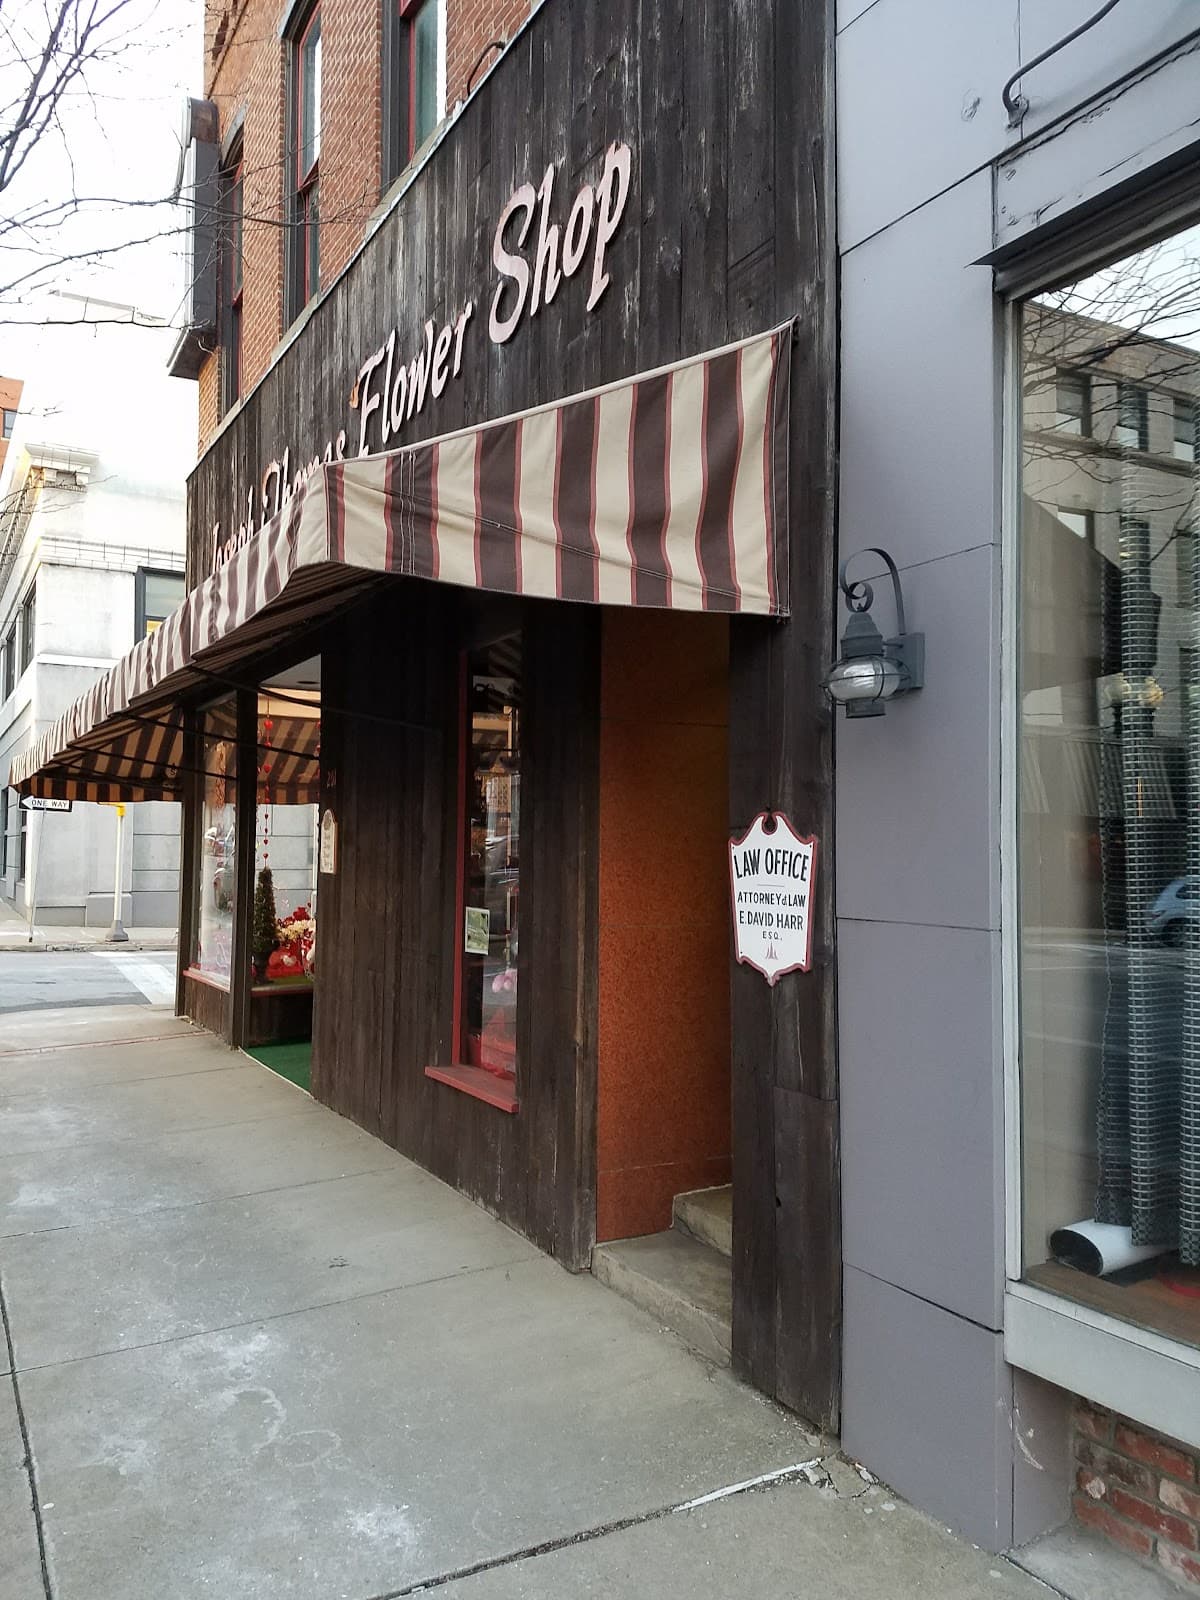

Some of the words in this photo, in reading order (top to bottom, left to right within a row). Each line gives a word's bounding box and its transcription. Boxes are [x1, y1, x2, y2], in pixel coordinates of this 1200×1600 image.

[350, 301, 474, 458] Flower
[488, 139, 632, 344] Shop
[51, 801, 67, 809] WAY
[734, 848, 761, 879] LAW
[765, 848, 809, 882] OFFICE
[737, 891, 782, 905] ATTORNEY
[788, 895, 806, 908] LAW
[776, 913, 803, 930] HARR
